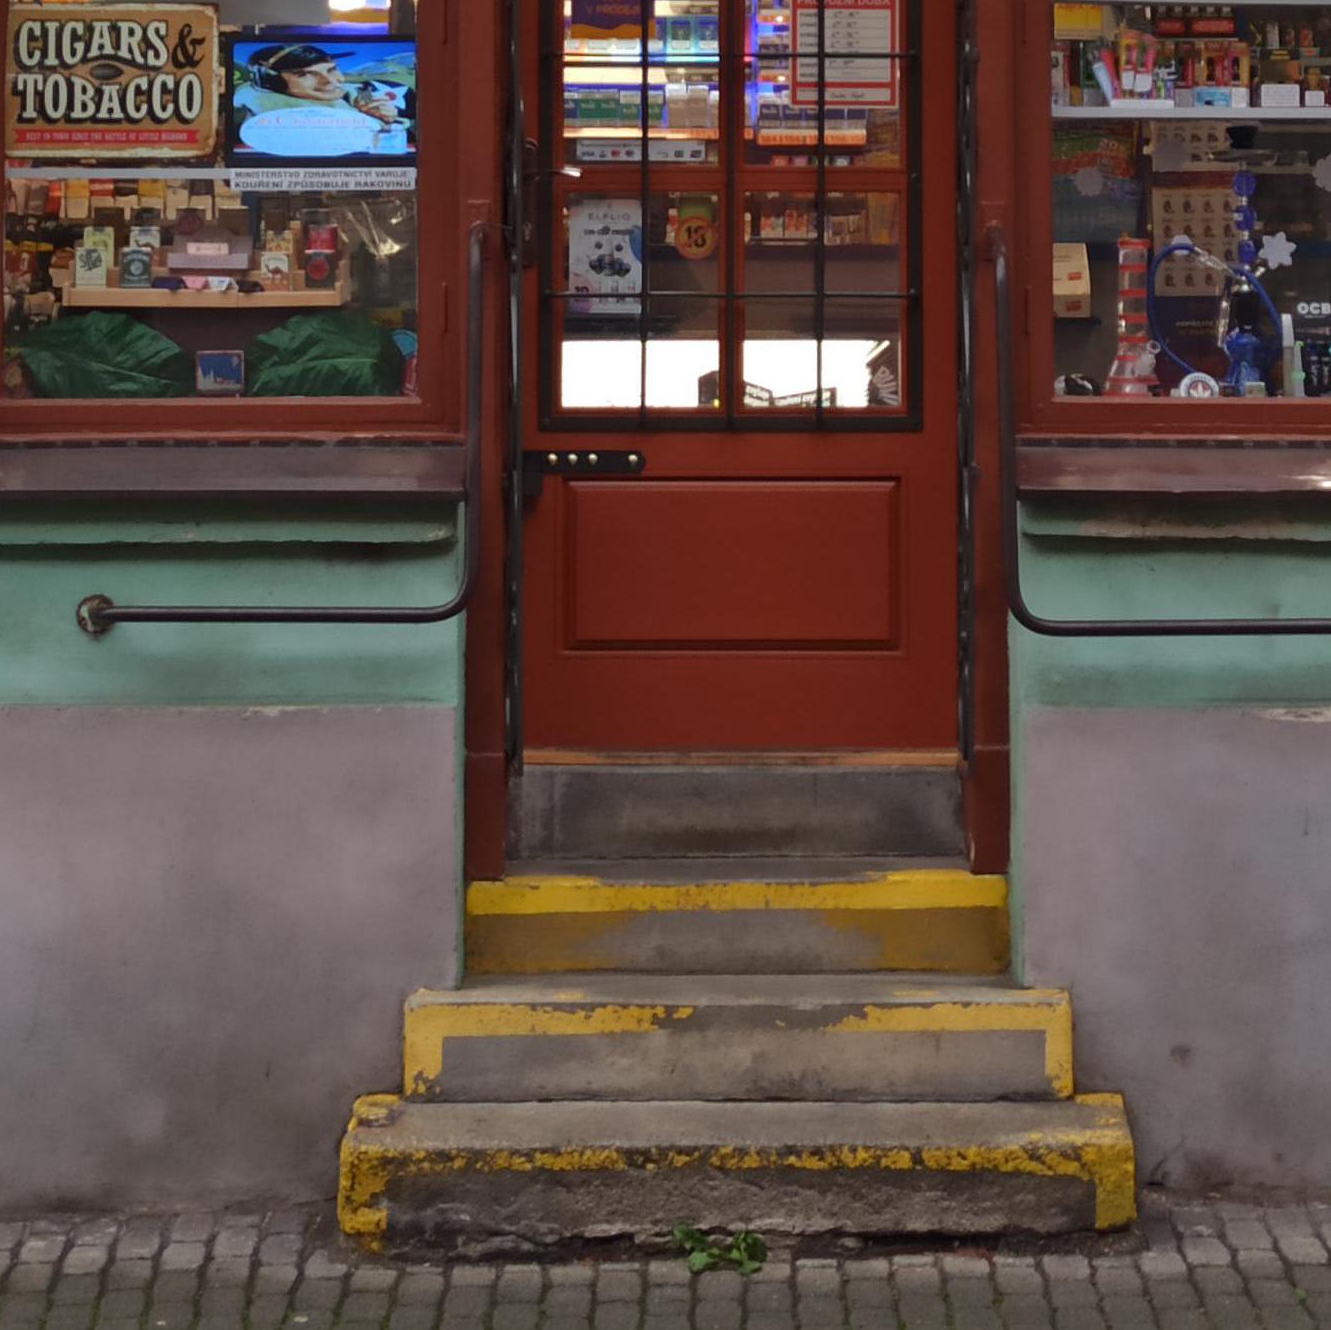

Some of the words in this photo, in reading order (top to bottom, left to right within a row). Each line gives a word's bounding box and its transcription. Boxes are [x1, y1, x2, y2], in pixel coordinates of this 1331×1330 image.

[17, 20, 169, 68] CIGARS
[171, 23, 206, 69] &
[16, 73, 205, 121] TOBACCO
[1297, 302, 1331, 315] OCB
